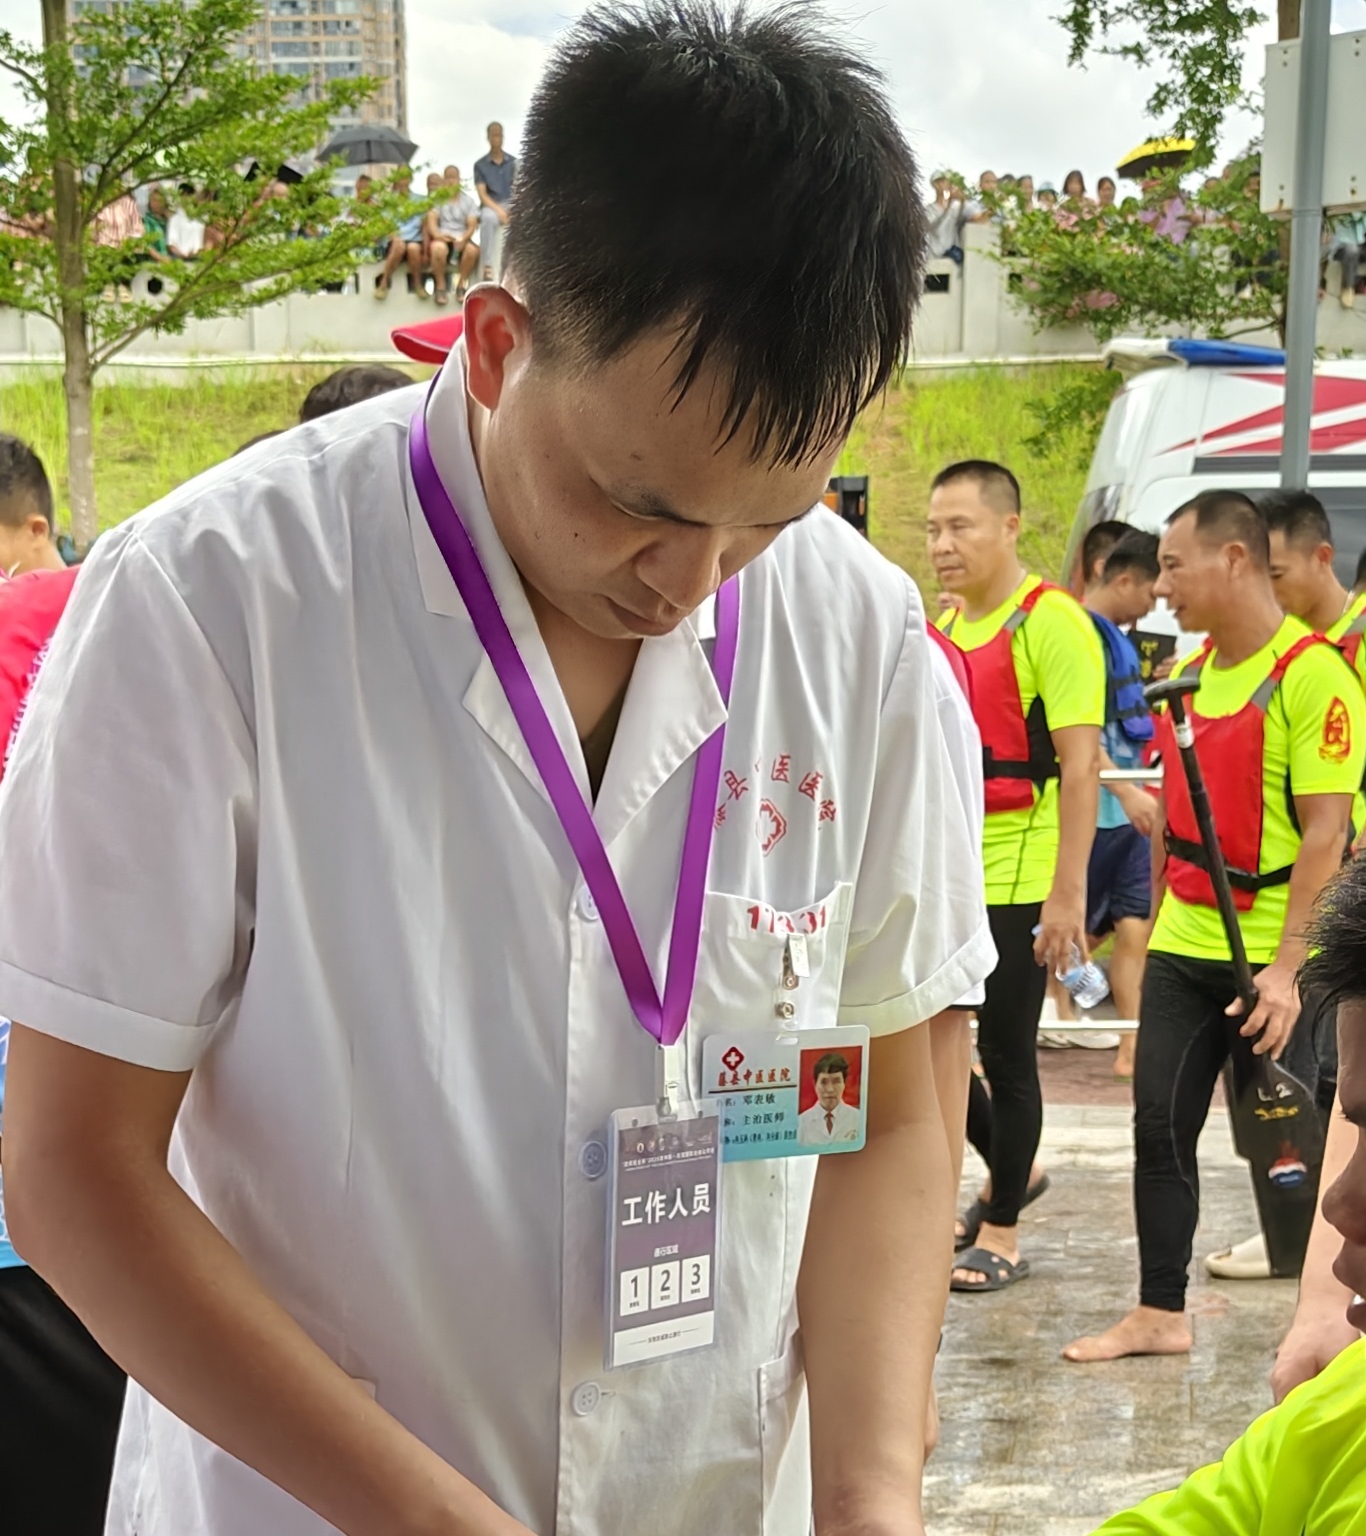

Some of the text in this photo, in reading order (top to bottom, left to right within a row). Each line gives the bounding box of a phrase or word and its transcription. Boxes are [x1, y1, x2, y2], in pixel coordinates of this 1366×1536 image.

[621, 1182, 712, 1227] 工作人员
[630, 1274, 639, 1299] 1
[660, 1269, 671, 1293] 2
[691, 1263, 701, 1287] 3
